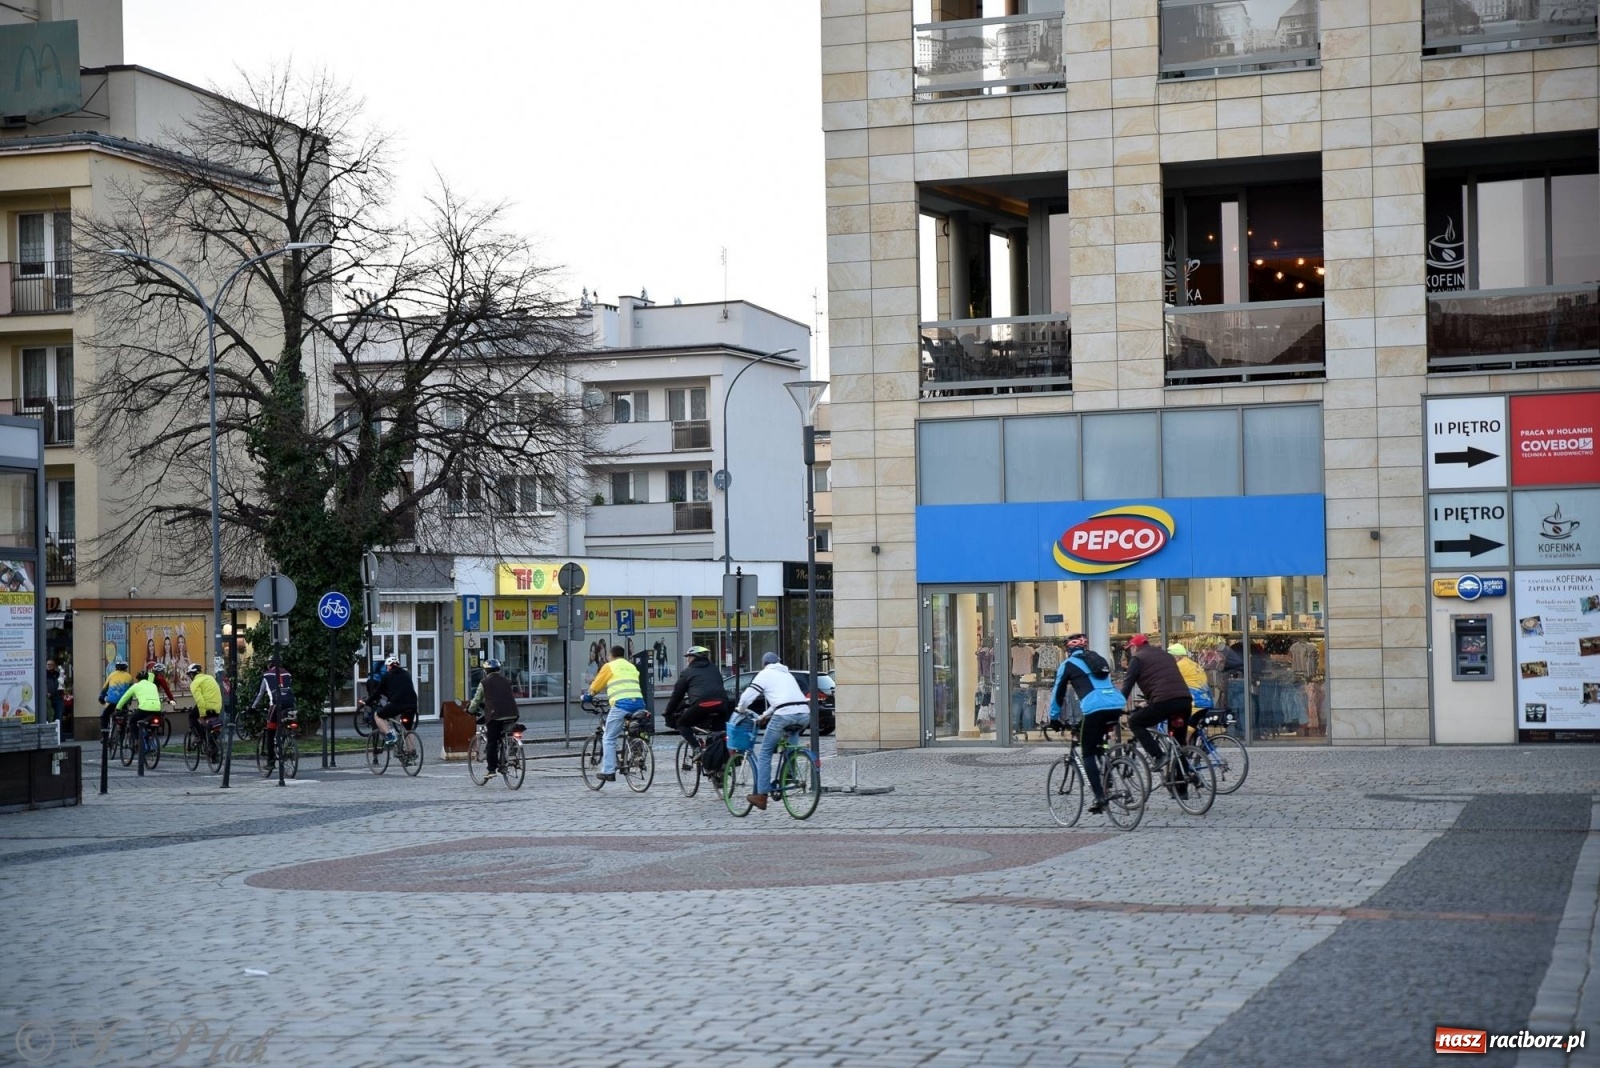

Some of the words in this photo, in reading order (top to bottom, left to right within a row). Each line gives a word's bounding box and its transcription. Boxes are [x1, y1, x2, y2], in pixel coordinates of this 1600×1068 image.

[1434, 422, 1443, 435] II
[1448, 419, 1501, 436] PIĘTRO
[1520, 429, 1545, 437] PRACA
[1546, 428, 1554, 436] W
[1556, 427, 1593, 435] HOLANDII
[1520, 438, 1579, 452] COVEBO
[1434, 507, 1438, 521] I
[1444, 505, 1505, 523] PIĘTRO
[1071, 528, 1156, 551] PEPCO
[1538, 542, 1582, 553] KOFEINKA
[1556, 574, 1594, 583] KOFEINKA
[466, 597, 477, 620] P
[620, 610, 629, 623] P
